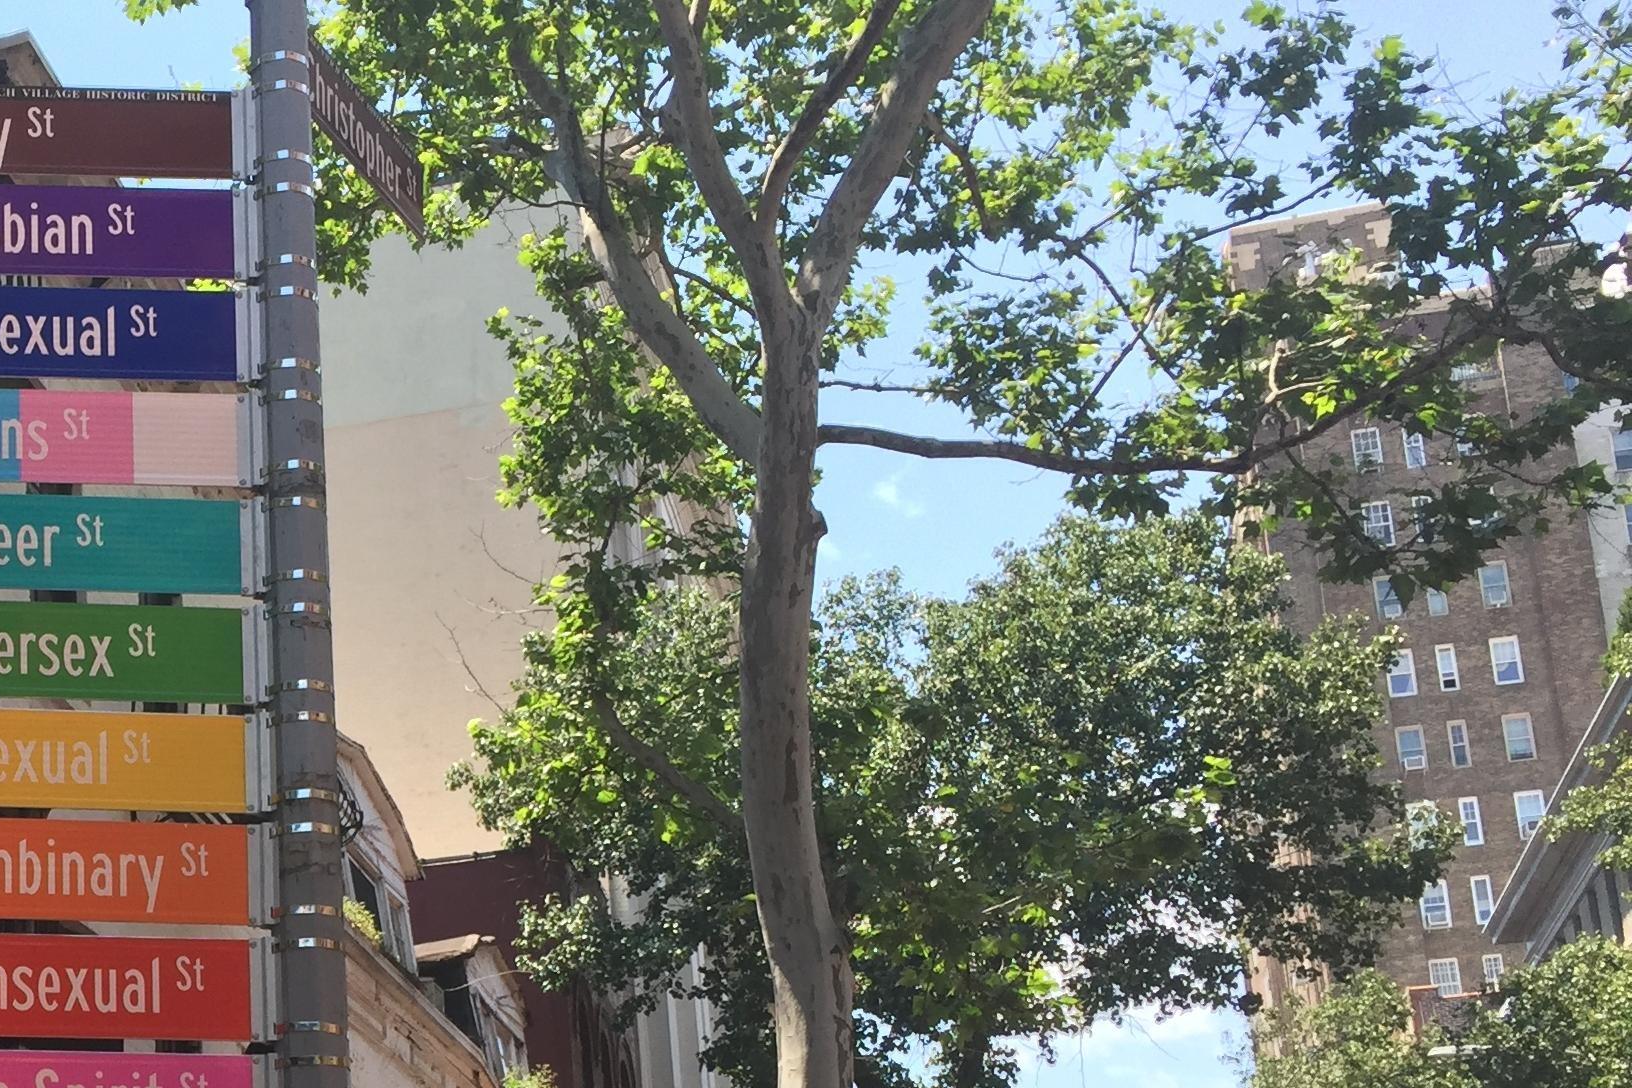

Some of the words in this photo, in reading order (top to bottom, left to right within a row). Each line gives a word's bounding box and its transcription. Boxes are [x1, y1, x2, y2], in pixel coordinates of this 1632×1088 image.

[22, 87, 80, 99] VILLAGE
[86, 89, 151, 101] HISTORIC
[156, 91, 218, 102] DISTRICT
[27, 106, 55, 138] St
[406, 166, 418, 201] St
[107, 203, 135, 235] St
[130, 304, 158, 338] St
[63, 407, 90, 441] St
[76, 513, 104, 547] St
[128, 623, 156, 658] St
[122, 729, 151, 765] St
[180, 841, 209, 877] St
[175, 955, 205, 992] St
